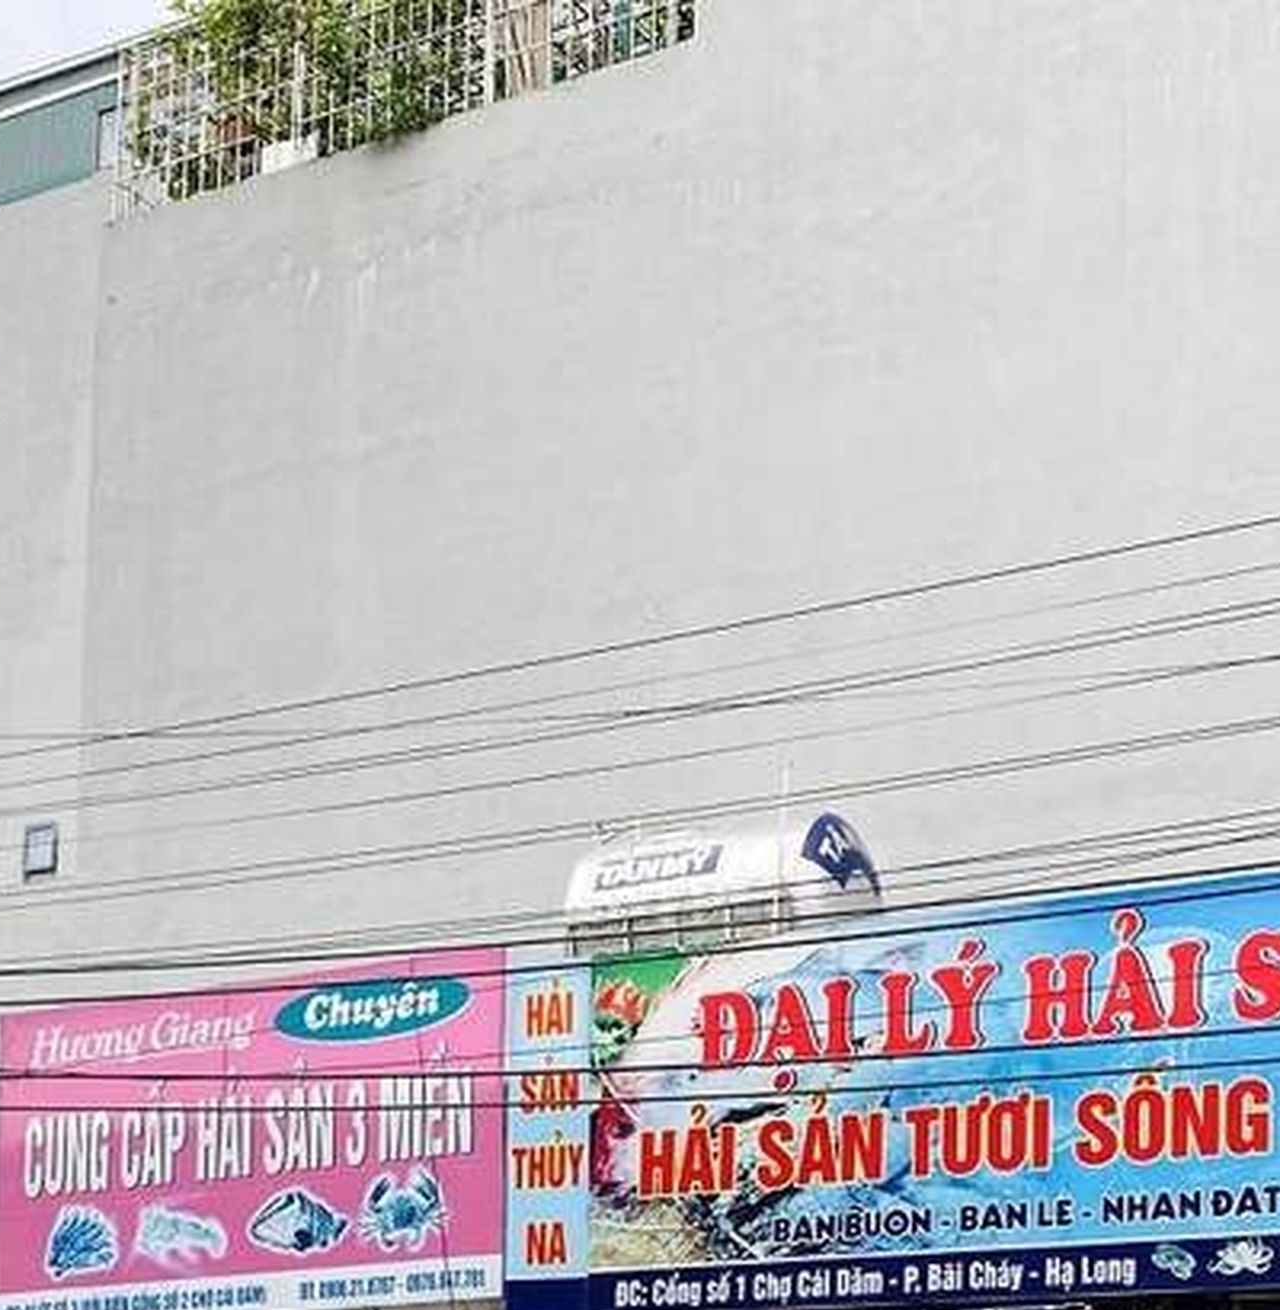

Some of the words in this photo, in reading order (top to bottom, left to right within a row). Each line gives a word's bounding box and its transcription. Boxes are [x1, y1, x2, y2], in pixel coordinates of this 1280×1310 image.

[303, 982, 440, 1030] Chuyên
[697, 970, 856, 1094] ĐẠI
[877, 940, 1000, 1056] LÝ
[1024, 909, 1209, 1043] HẢI
[150, 1010, 256, 1051] Giang
[25, 1110, 111, 1198] CUNG
[346, 1078, 370, 1168] 3
[511, 1128, 584, 1190] THỦY
[637, 1102, 734, 1200] HẢI
[754, 1090, 888, 1196] SẢN
[905, 1092, 1051, 1178] TƯƠI
[525, 1221, 567, 1266] NA
[706, 1269, 734, 1304] số
[734, 1274, 747, 1302] 1
[751, 1271, 793, 1305] Chợ
[903, 1264, 922, 1294] P.
[968, 1258, 1025, 1292] Cháy
[1044, 1255, 1075, 1292] Hạ
[1080, 1255, 1138, 1288] Long
